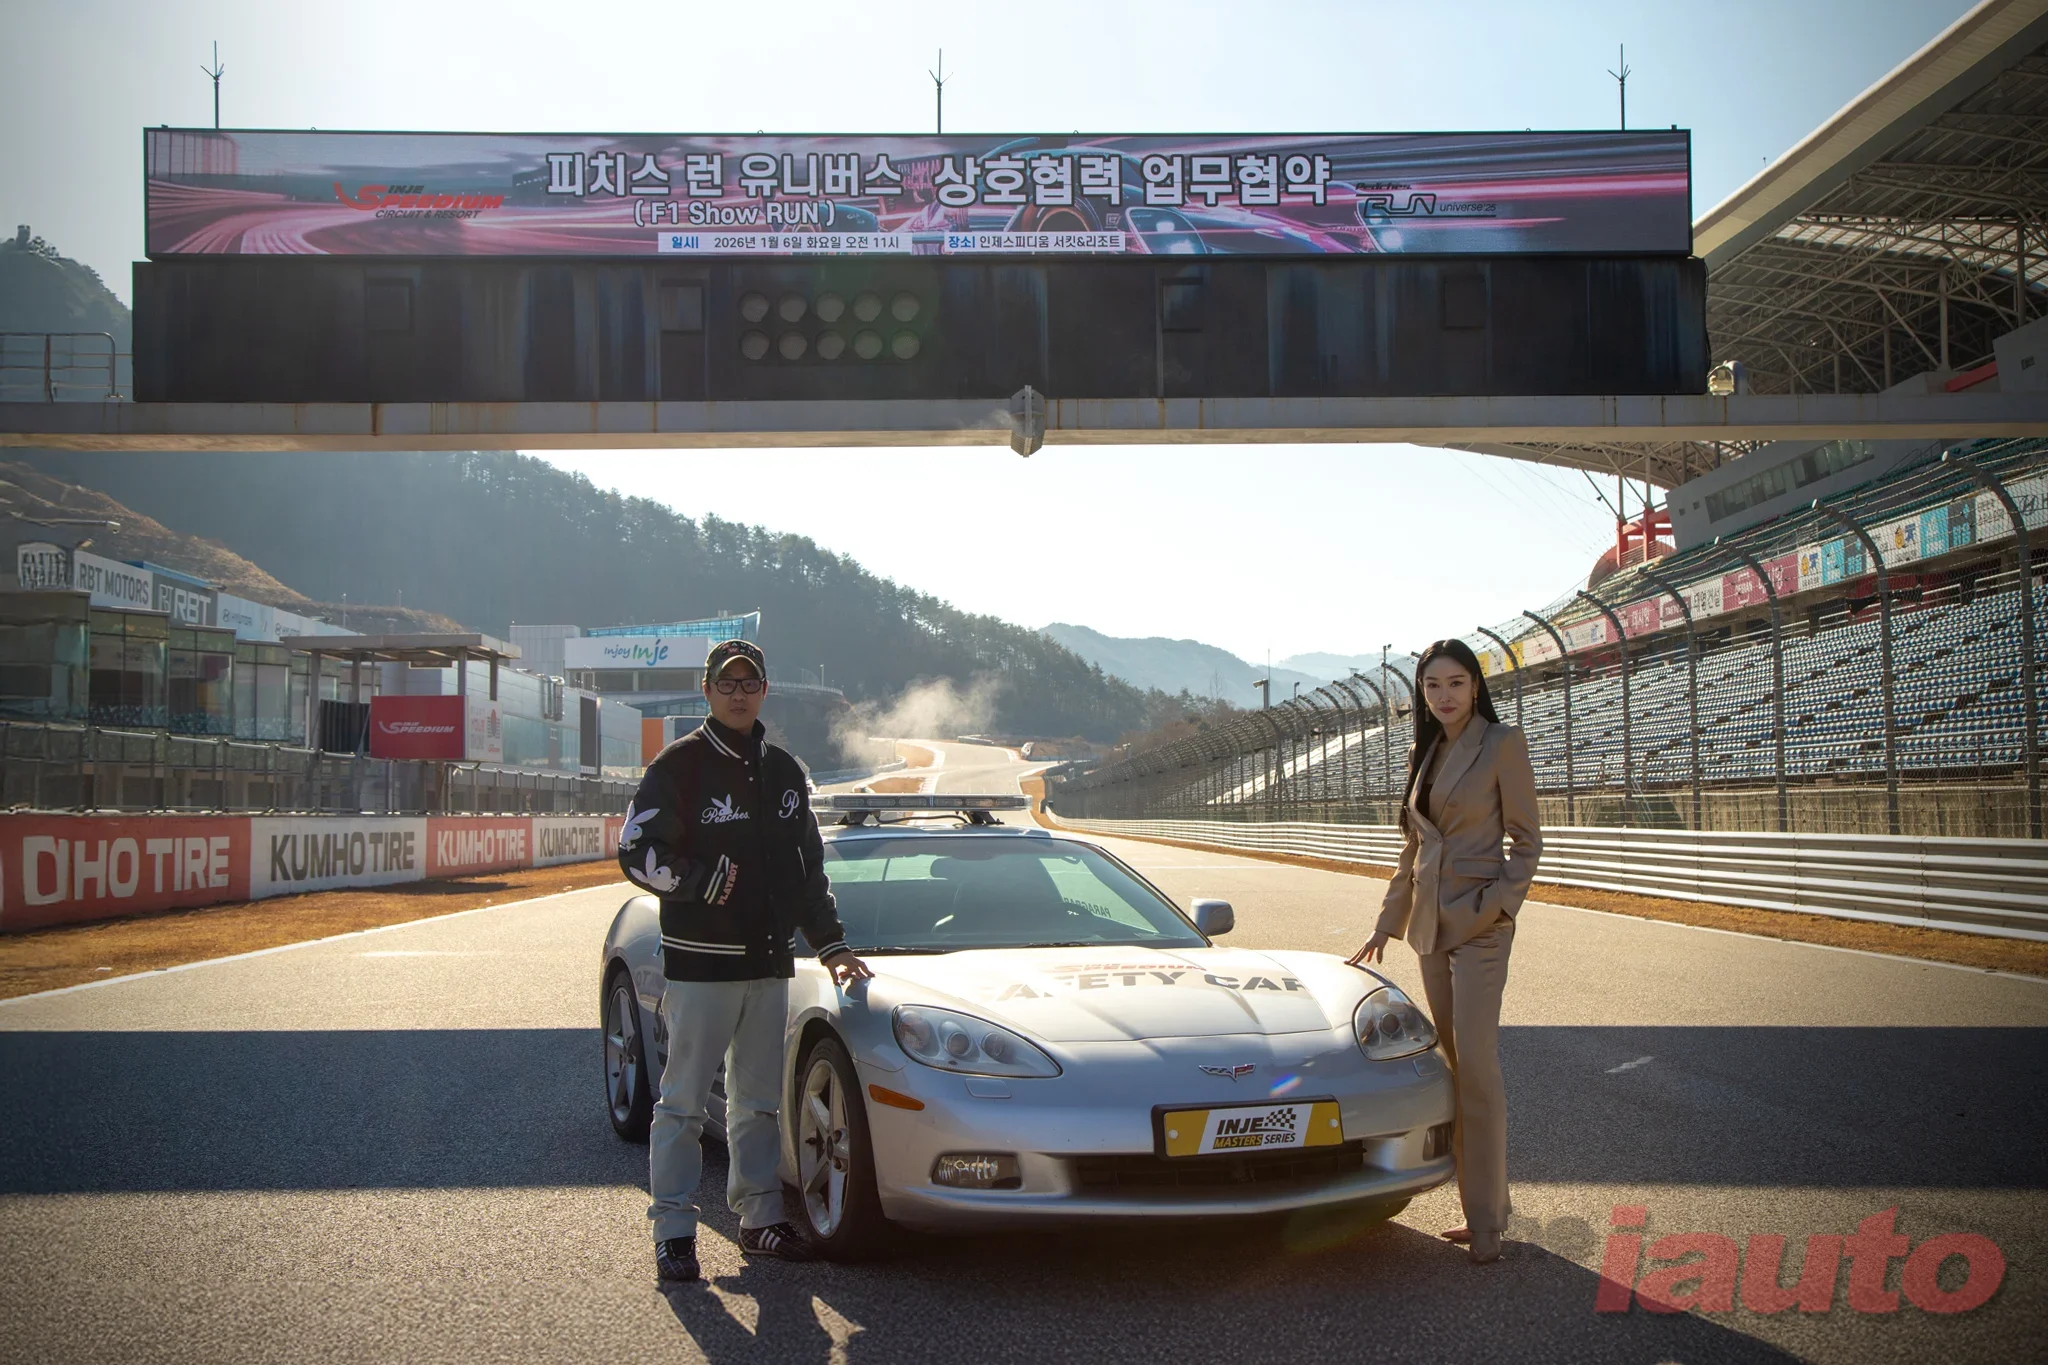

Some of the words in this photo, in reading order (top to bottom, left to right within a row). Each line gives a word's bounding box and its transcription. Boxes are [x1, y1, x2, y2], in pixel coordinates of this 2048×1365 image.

[388, 185, 424, 194] INJE
[547, 153, 669, 196] 피치스
[685, 153, 723, 197] 런
[740, 153, 902, 197] 유니버스
[934, 155, 1121, 206] 상호협력
[1142, 155, 1331, 205] 업무협약
[375, 210, 422, 219] CIRCUIT
[424, 210, 431, 219] &
[434, 210, 482, 219] RESORT
[688, 201, 759, 226] Show
[765, 201, 820, 226] RUN
[714, 237, 756, 249] 2026년
[761, 237, 779, 249] 1월
[783, 237, 803, 249] 6일
[807, 237, 841, 249] 화요일
[846, 237, 868, 249] 오전
[873, 237, 899, 249] 11시
[980, 236, 1050, 248] 인제스피디움
[1054, 236, 1121, 248] 서킷&리조트
[79, 563, 103, 593] RBT
[105, 569, 149, 605] MOTORS
[174, 588, 211, 626] RBT
[378, 721, 456, 734] SPEEDIUM
[271, 831, 366, 882] KUMHO
[369, 831, 415, 873] TIRE
[437, 829, 495, 867] KUMHO
[496, 829, 526, 861] TIRE
[539, 827, 578, 858] KUMHO
[578, 827, 600, 854] TIRE
[146, 836, 230, 893] TIRE
[717, 862, 738, 905] PLAYBOY
[1216, 1116, 1265, 1136] INJE
[1213, 1134, 1263, 1149] MASTERS
[1264, 1132, 1296, 1145] SERIES
